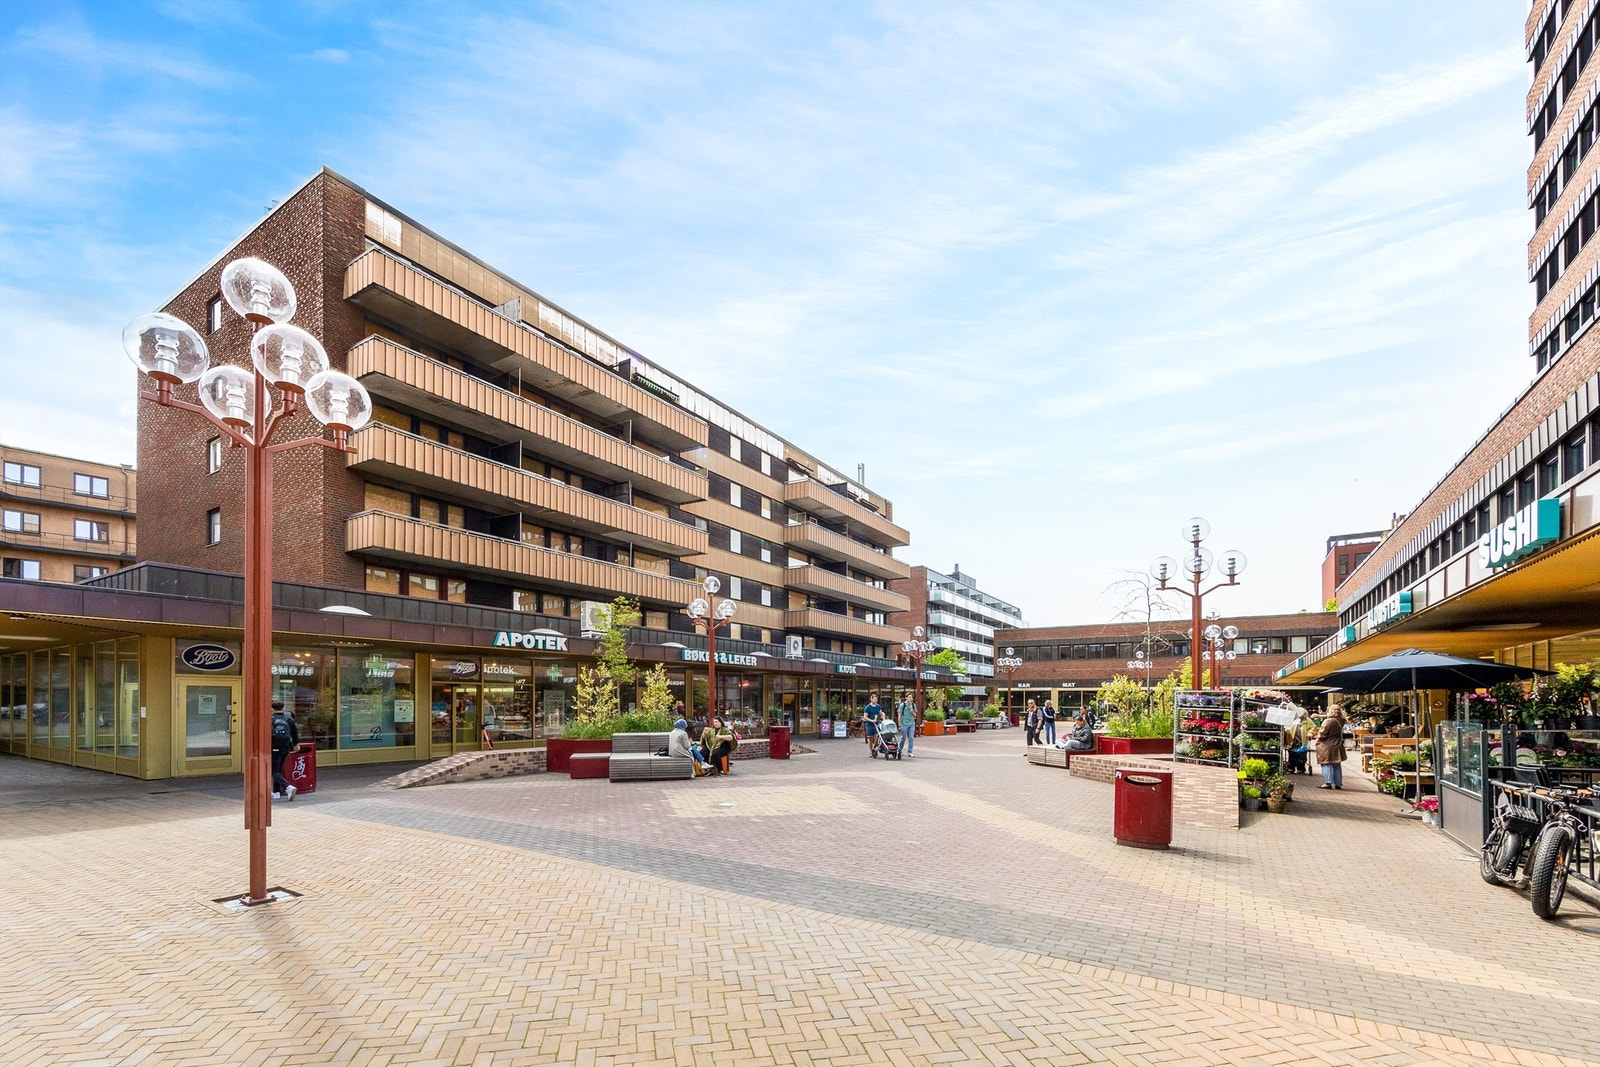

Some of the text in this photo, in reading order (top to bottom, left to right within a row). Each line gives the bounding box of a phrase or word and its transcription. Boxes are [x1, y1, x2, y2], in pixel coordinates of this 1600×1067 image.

[1478, 499, 1539, 569] SUSHI
[495, 631, 568, 651] APOTEK
[719, 652, 728, 664] &
[729, 654, 757, 666] LEKER
[839, 664, 857, 674] KIOSK
